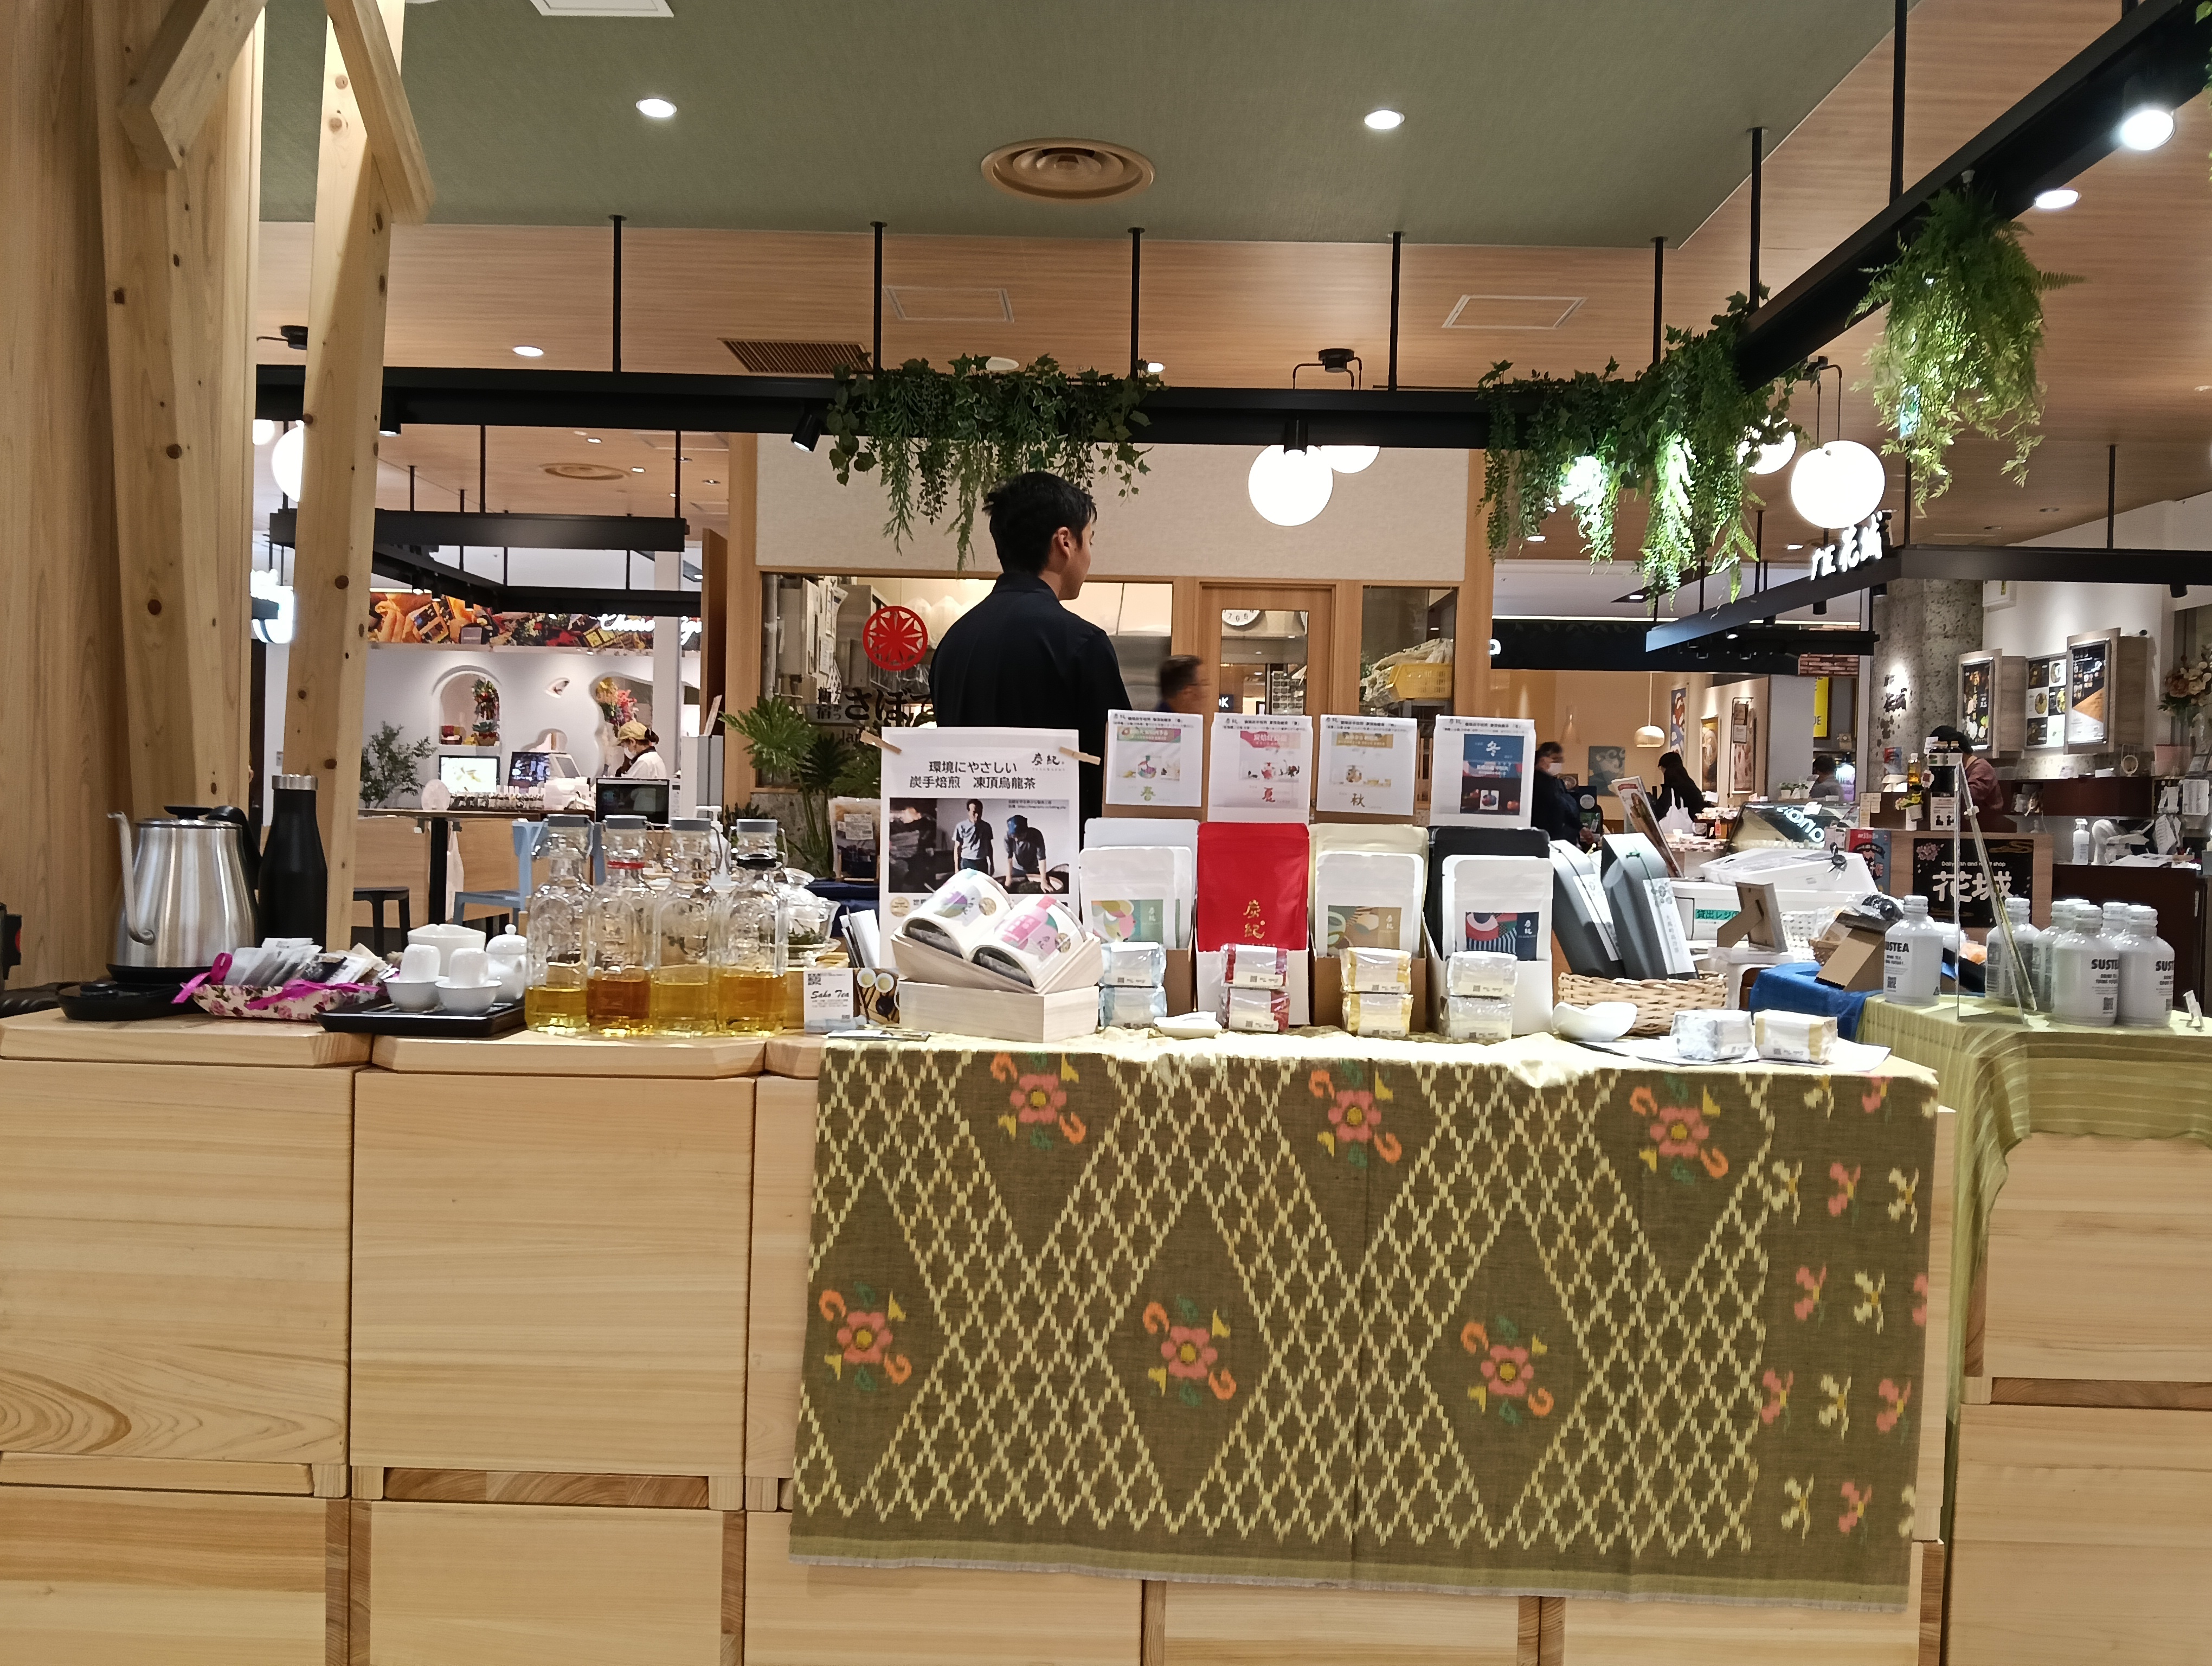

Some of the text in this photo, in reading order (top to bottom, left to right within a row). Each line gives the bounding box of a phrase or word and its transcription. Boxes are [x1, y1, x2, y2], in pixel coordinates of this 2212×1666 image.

[1486, 741, 1501, 757] 冬
[929, 761, 1017, 773] 環境にやさしい
[910, 776, 961, 789] 炭手焙煎
[1141, 786, 1155, 802] 春
[1262, 787, 1276, 802] 夏
[1351, 793, 1365, 808] 秋
[1932, 871, 2013, 902] 花城
